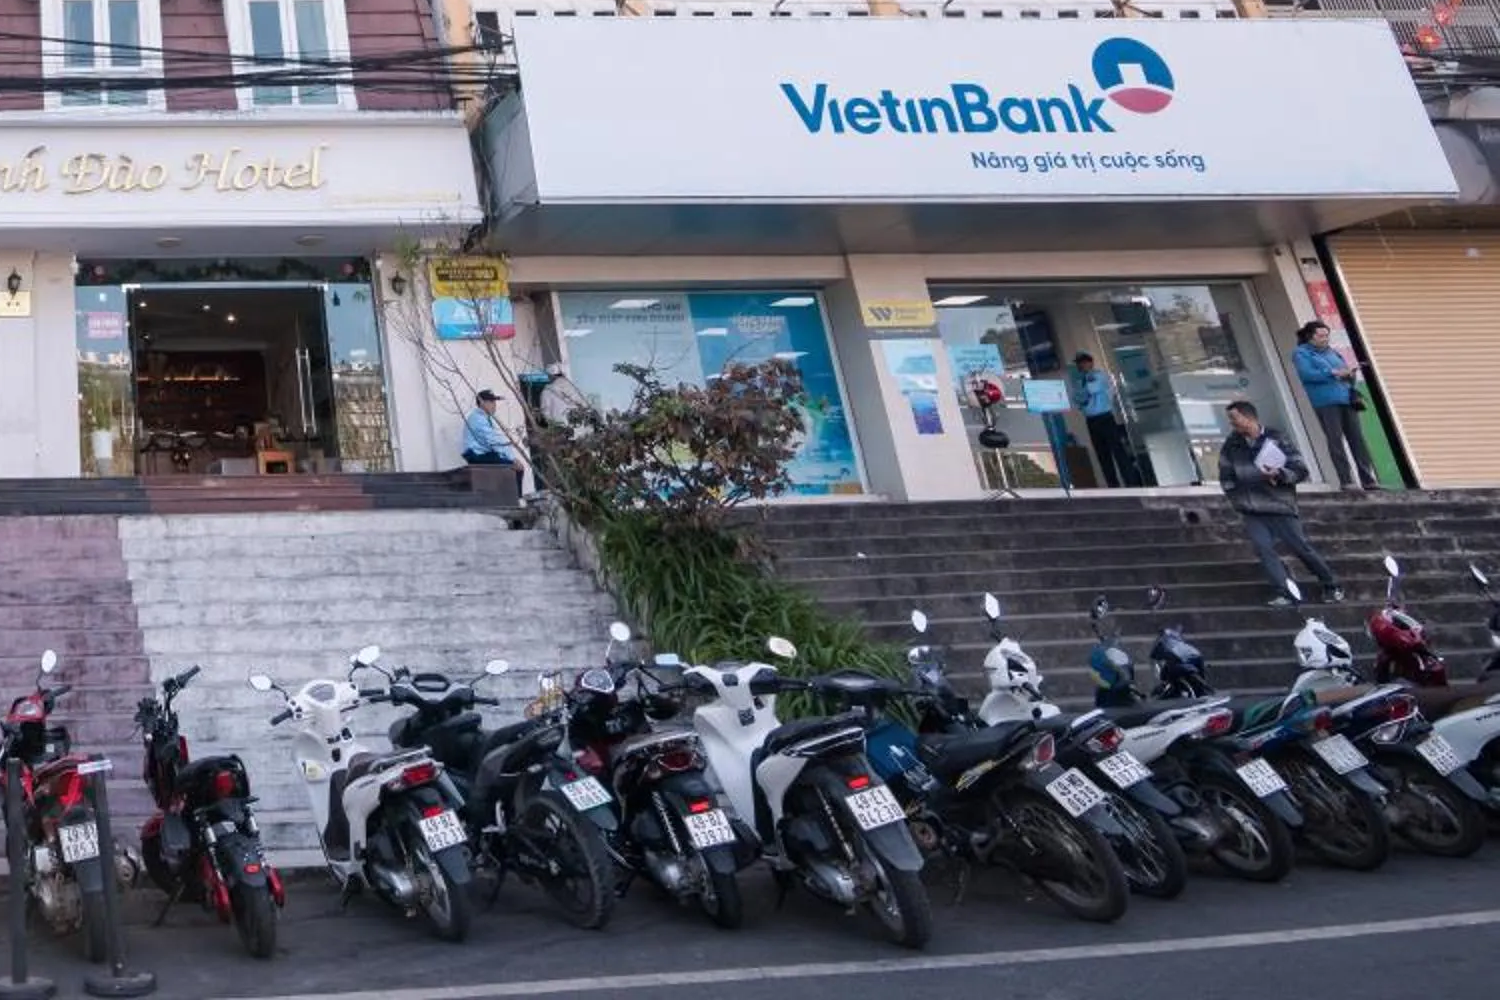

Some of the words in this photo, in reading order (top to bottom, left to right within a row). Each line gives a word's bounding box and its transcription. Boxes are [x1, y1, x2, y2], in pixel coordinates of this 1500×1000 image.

[780, 82, 1117, 135] VietinBank
[61, 152, 168, 195] Đào
[179, 143, 330, 192] Hotel
[971, 151, 1029, 172] Nâng
[1033, 151, 1067, 172] giá
[1071, 151, 1097, 173] trị
[1100, 151, 1150, 173] cuộc
[1155, 148, 1206, 173] sống
